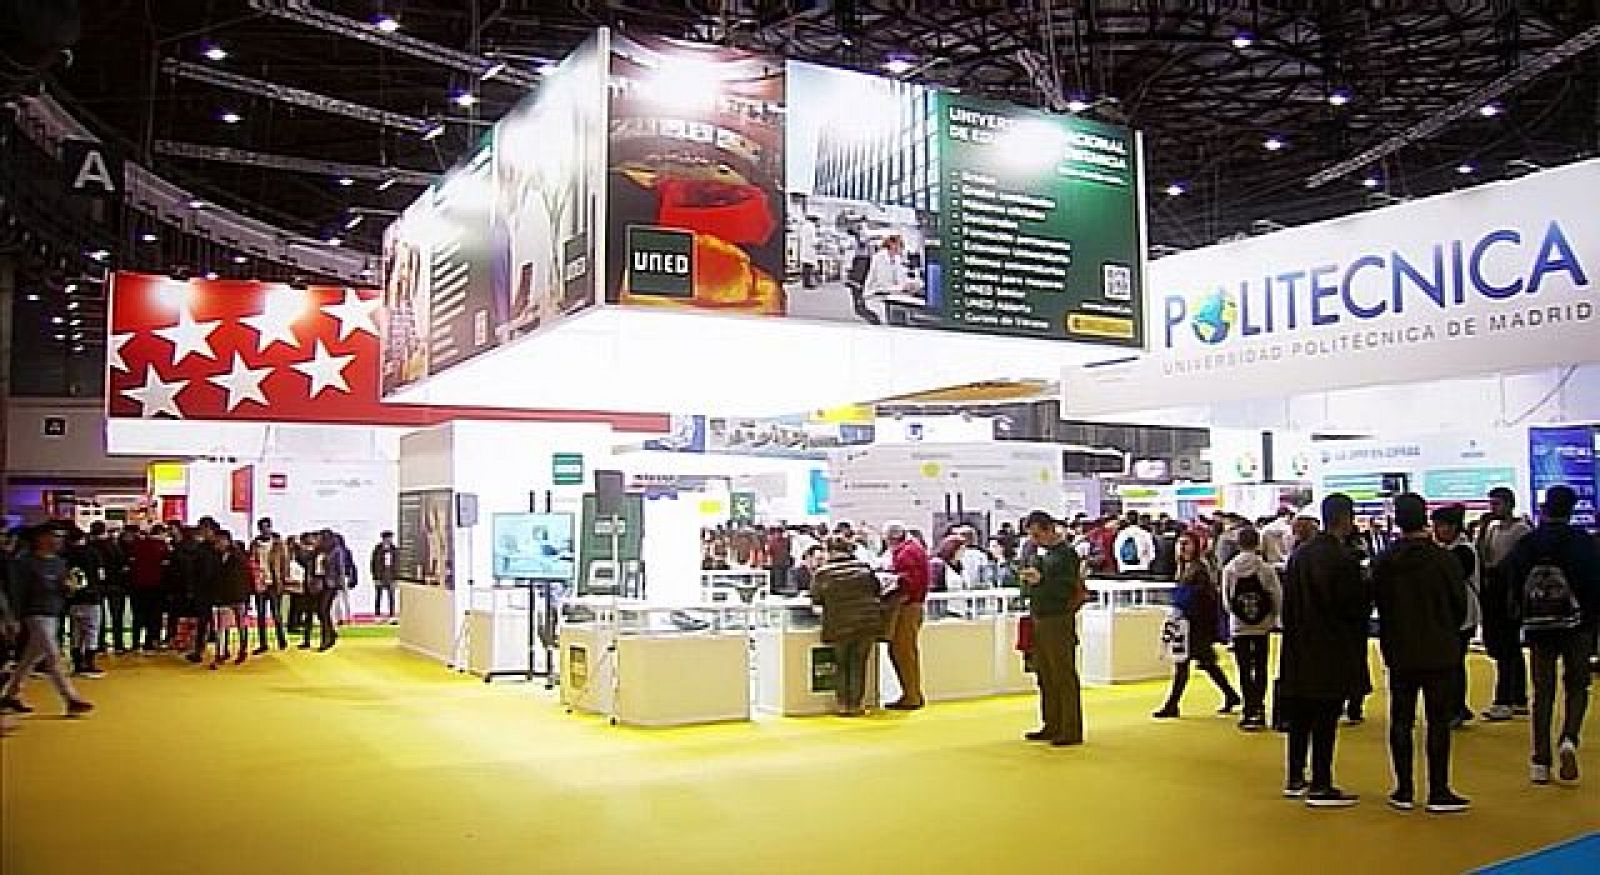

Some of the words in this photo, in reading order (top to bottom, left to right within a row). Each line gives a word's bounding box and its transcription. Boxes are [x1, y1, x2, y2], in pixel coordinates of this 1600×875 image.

[73, 151, 115, 191] A
[634, 251, 689, 274] UNED
[1161, 346, 1283, 377] UNIVERSIDAD
[1447, 318, 1478, 337] DE
[1489, 302, 1592, 331] MADRID
